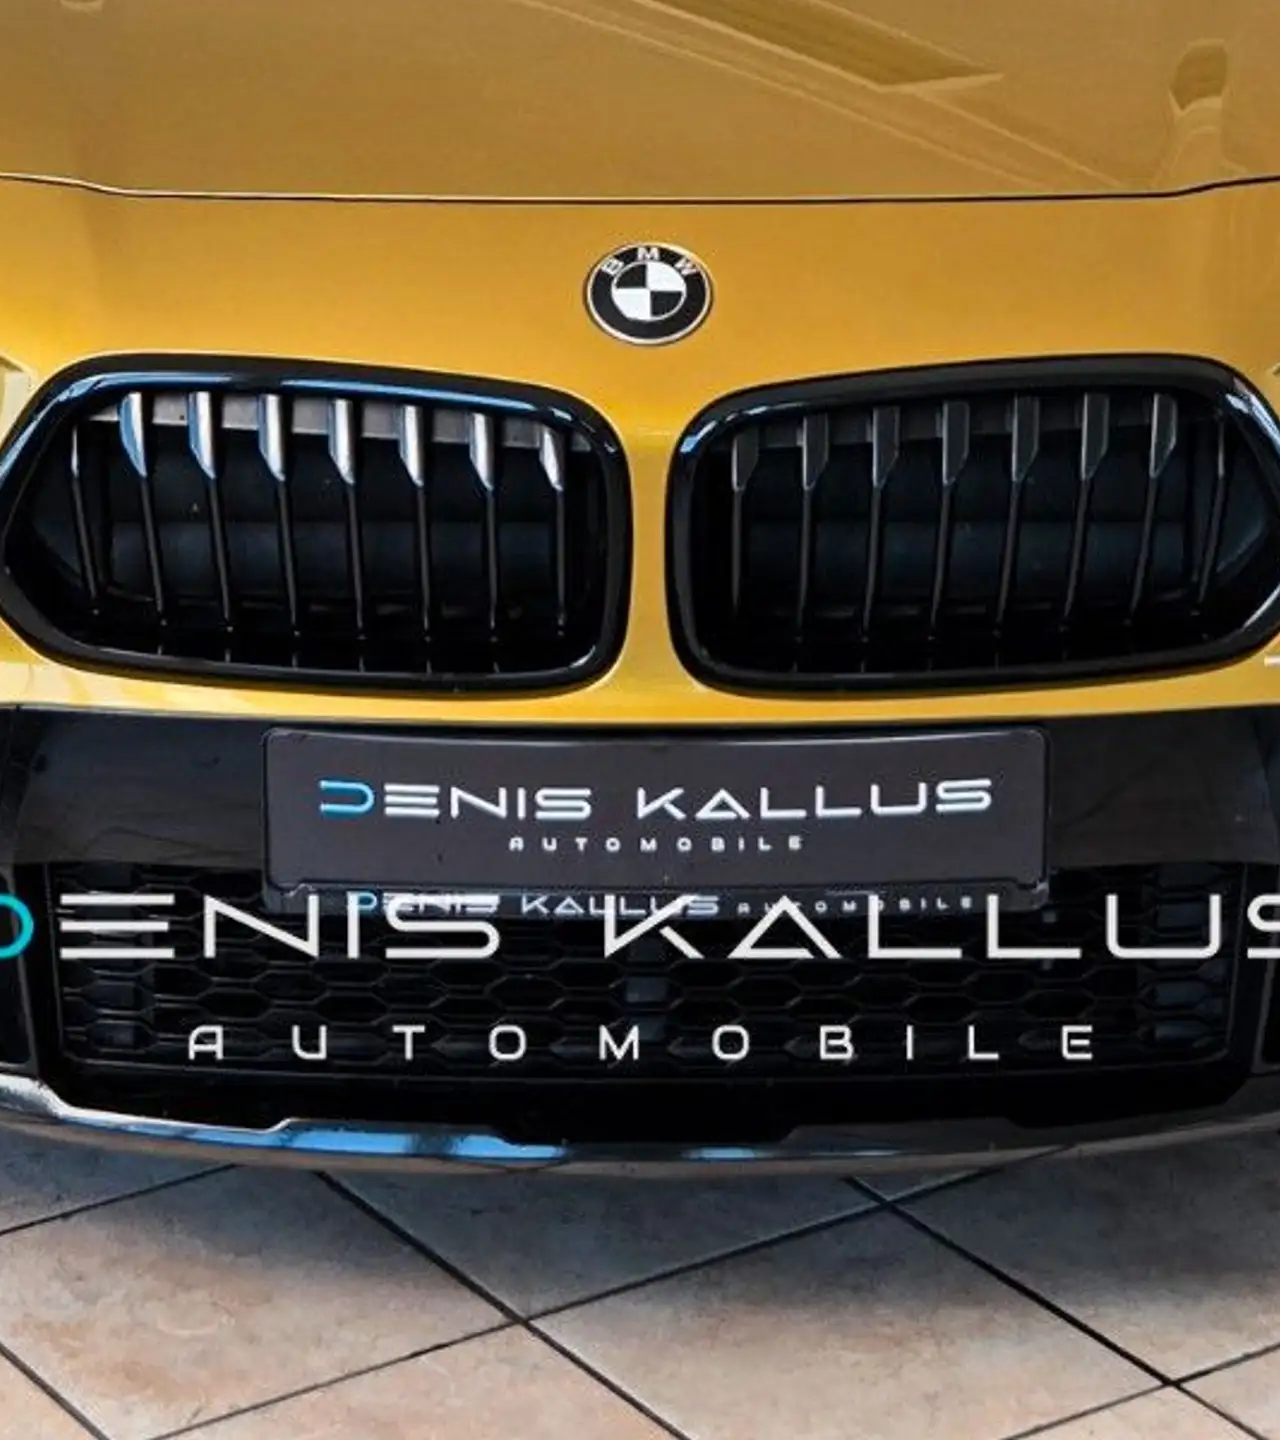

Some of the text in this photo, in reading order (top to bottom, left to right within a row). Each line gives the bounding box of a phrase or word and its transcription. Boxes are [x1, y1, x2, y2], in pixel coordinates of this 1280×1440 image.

[600, 245, 701, 276] BMW
[318, 778, 993, 821] DENIS KALLUS
[508, 835, 803, 853] AUTOMOBILE
[736, 896, 973, 914] AOMOBILE
